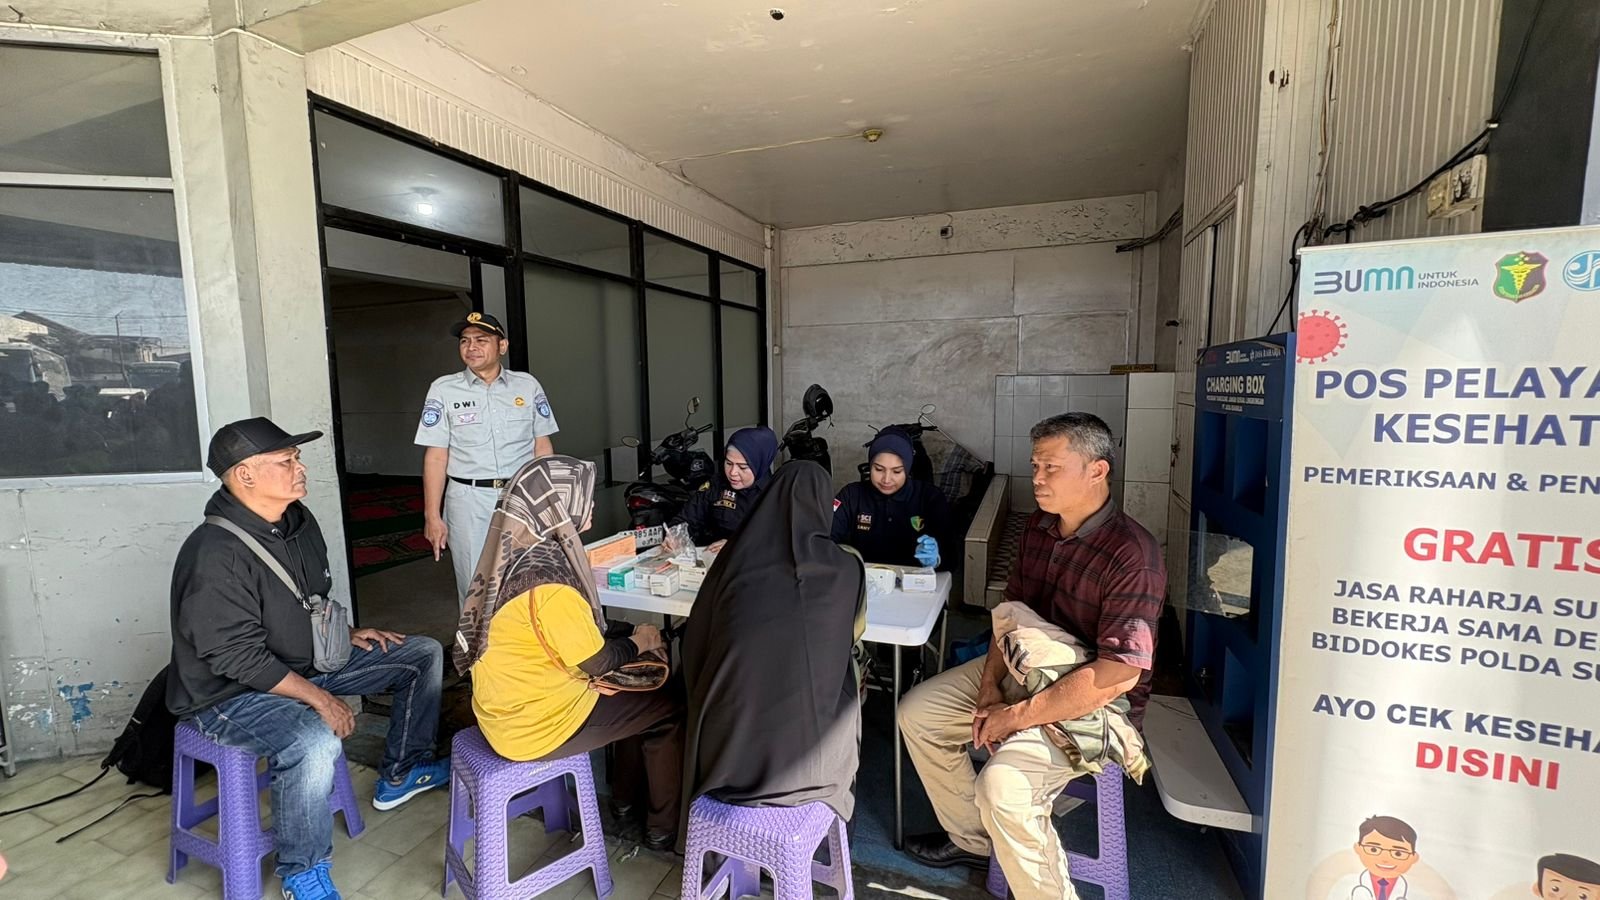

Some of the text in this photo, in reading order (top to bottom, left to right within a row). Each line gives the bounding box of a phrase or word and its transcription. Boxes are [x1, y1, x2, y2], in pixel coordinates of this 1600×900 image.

[1314, 266, 1414, 294] BUMN
[1418, 270, 1458, 280] UNTUK
[1418, 278, 1479, 289] INDONESIA
[1206, 375, 1265, 394] CHARGING BOX
[1315, 368, 1408, 399] POS
[454, 401, 476, 409] DWI
[1374, 412, 1600, 446] KESEHAT
[1304, 466, 1600, 495] PEMERIKSAAN & PEN
[1404, 528, 1600, 575] GRATIS
[1333, 579, 1598, 620] JASA RAHARJA SU
[1332, 608, 1600, 652] BEKERJA SAMA DE
[1312, 632, 1600, 682] BIDDOKES POLDA S
[1312, 694, 1600, 753] AYO CEK KESEH
[1416, 742, 1560, 790] DISINI
